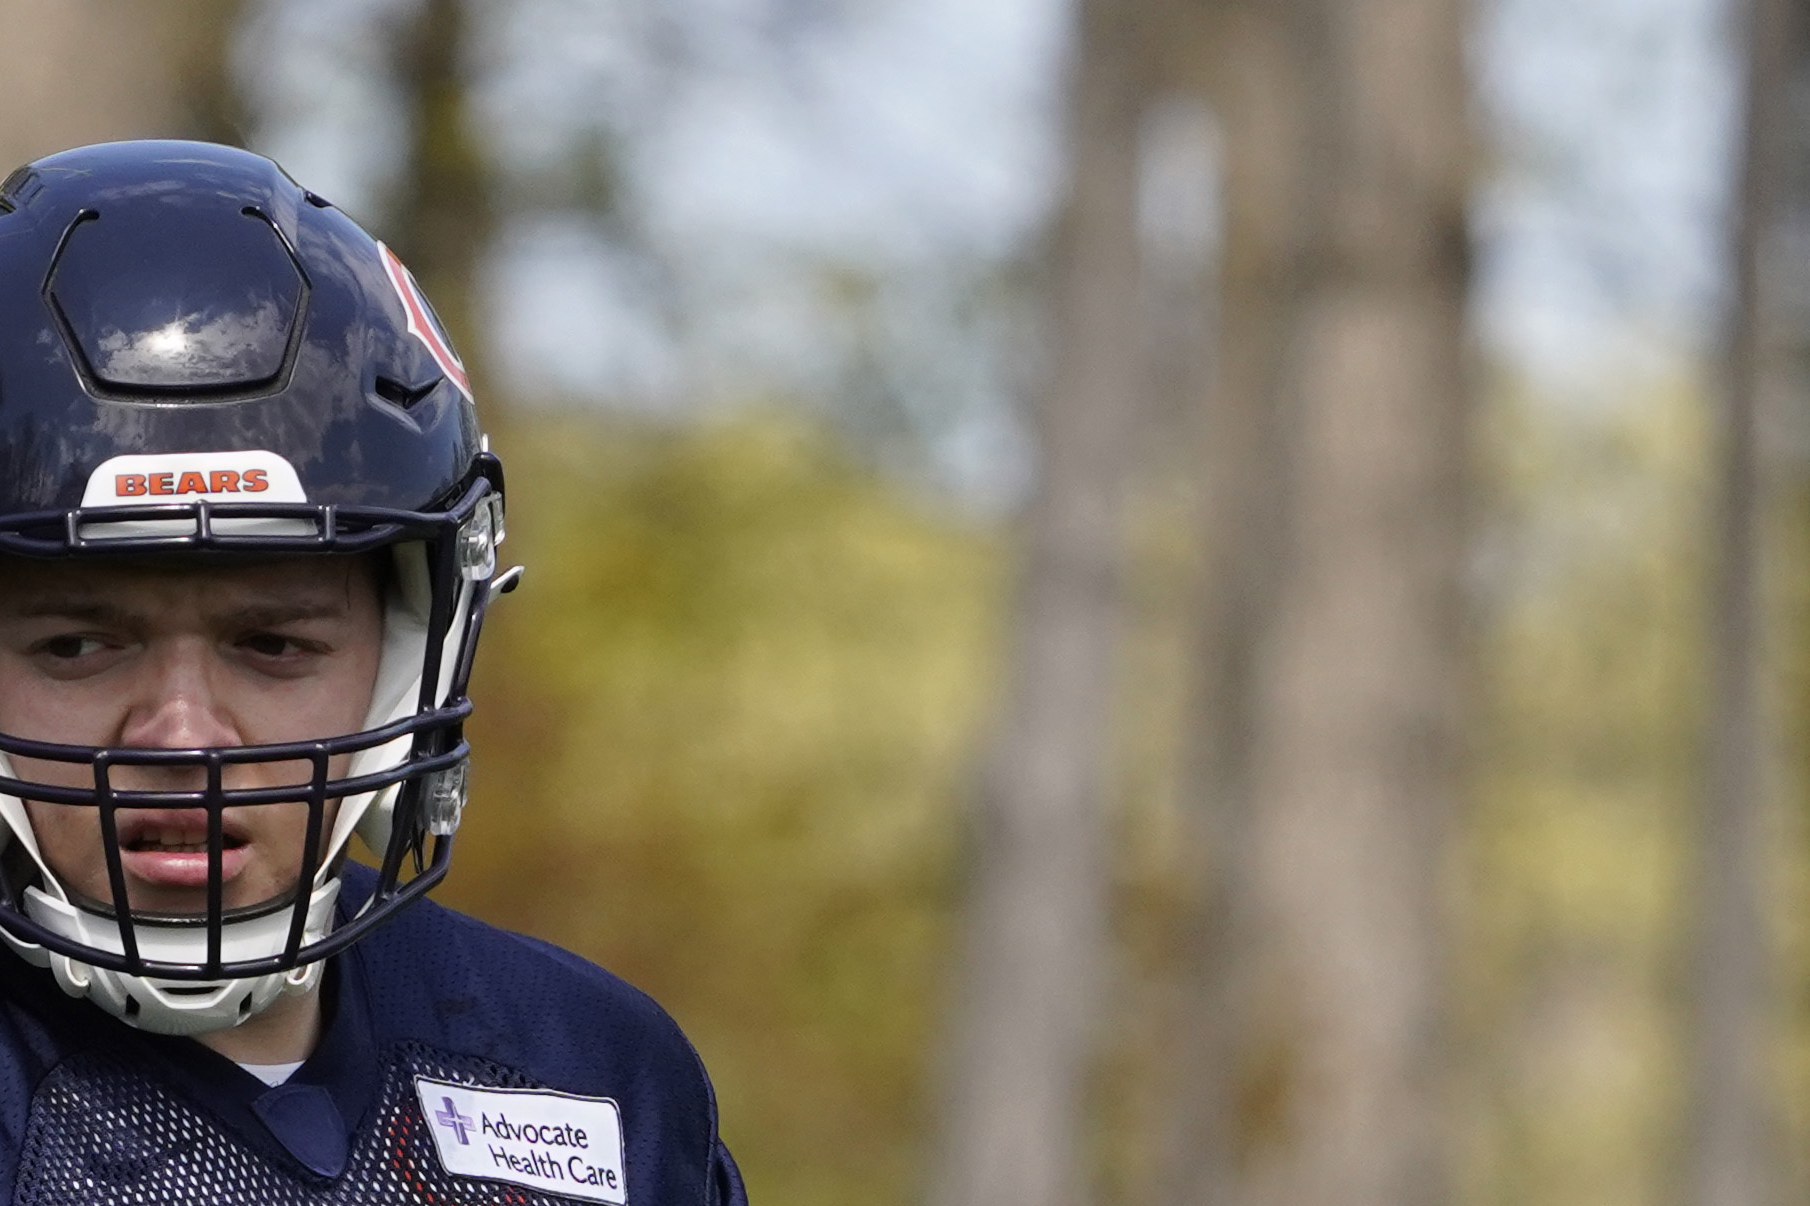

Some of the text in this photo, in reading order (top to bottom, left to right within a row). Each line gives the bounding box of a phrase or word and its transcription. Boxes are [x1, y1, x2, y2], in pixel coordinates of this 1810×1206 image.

[115, 468, 269, 497] BEARS
[482, 1112, 588, 1149] Advocate
[487, 1143, 618, 1190] Health Care
